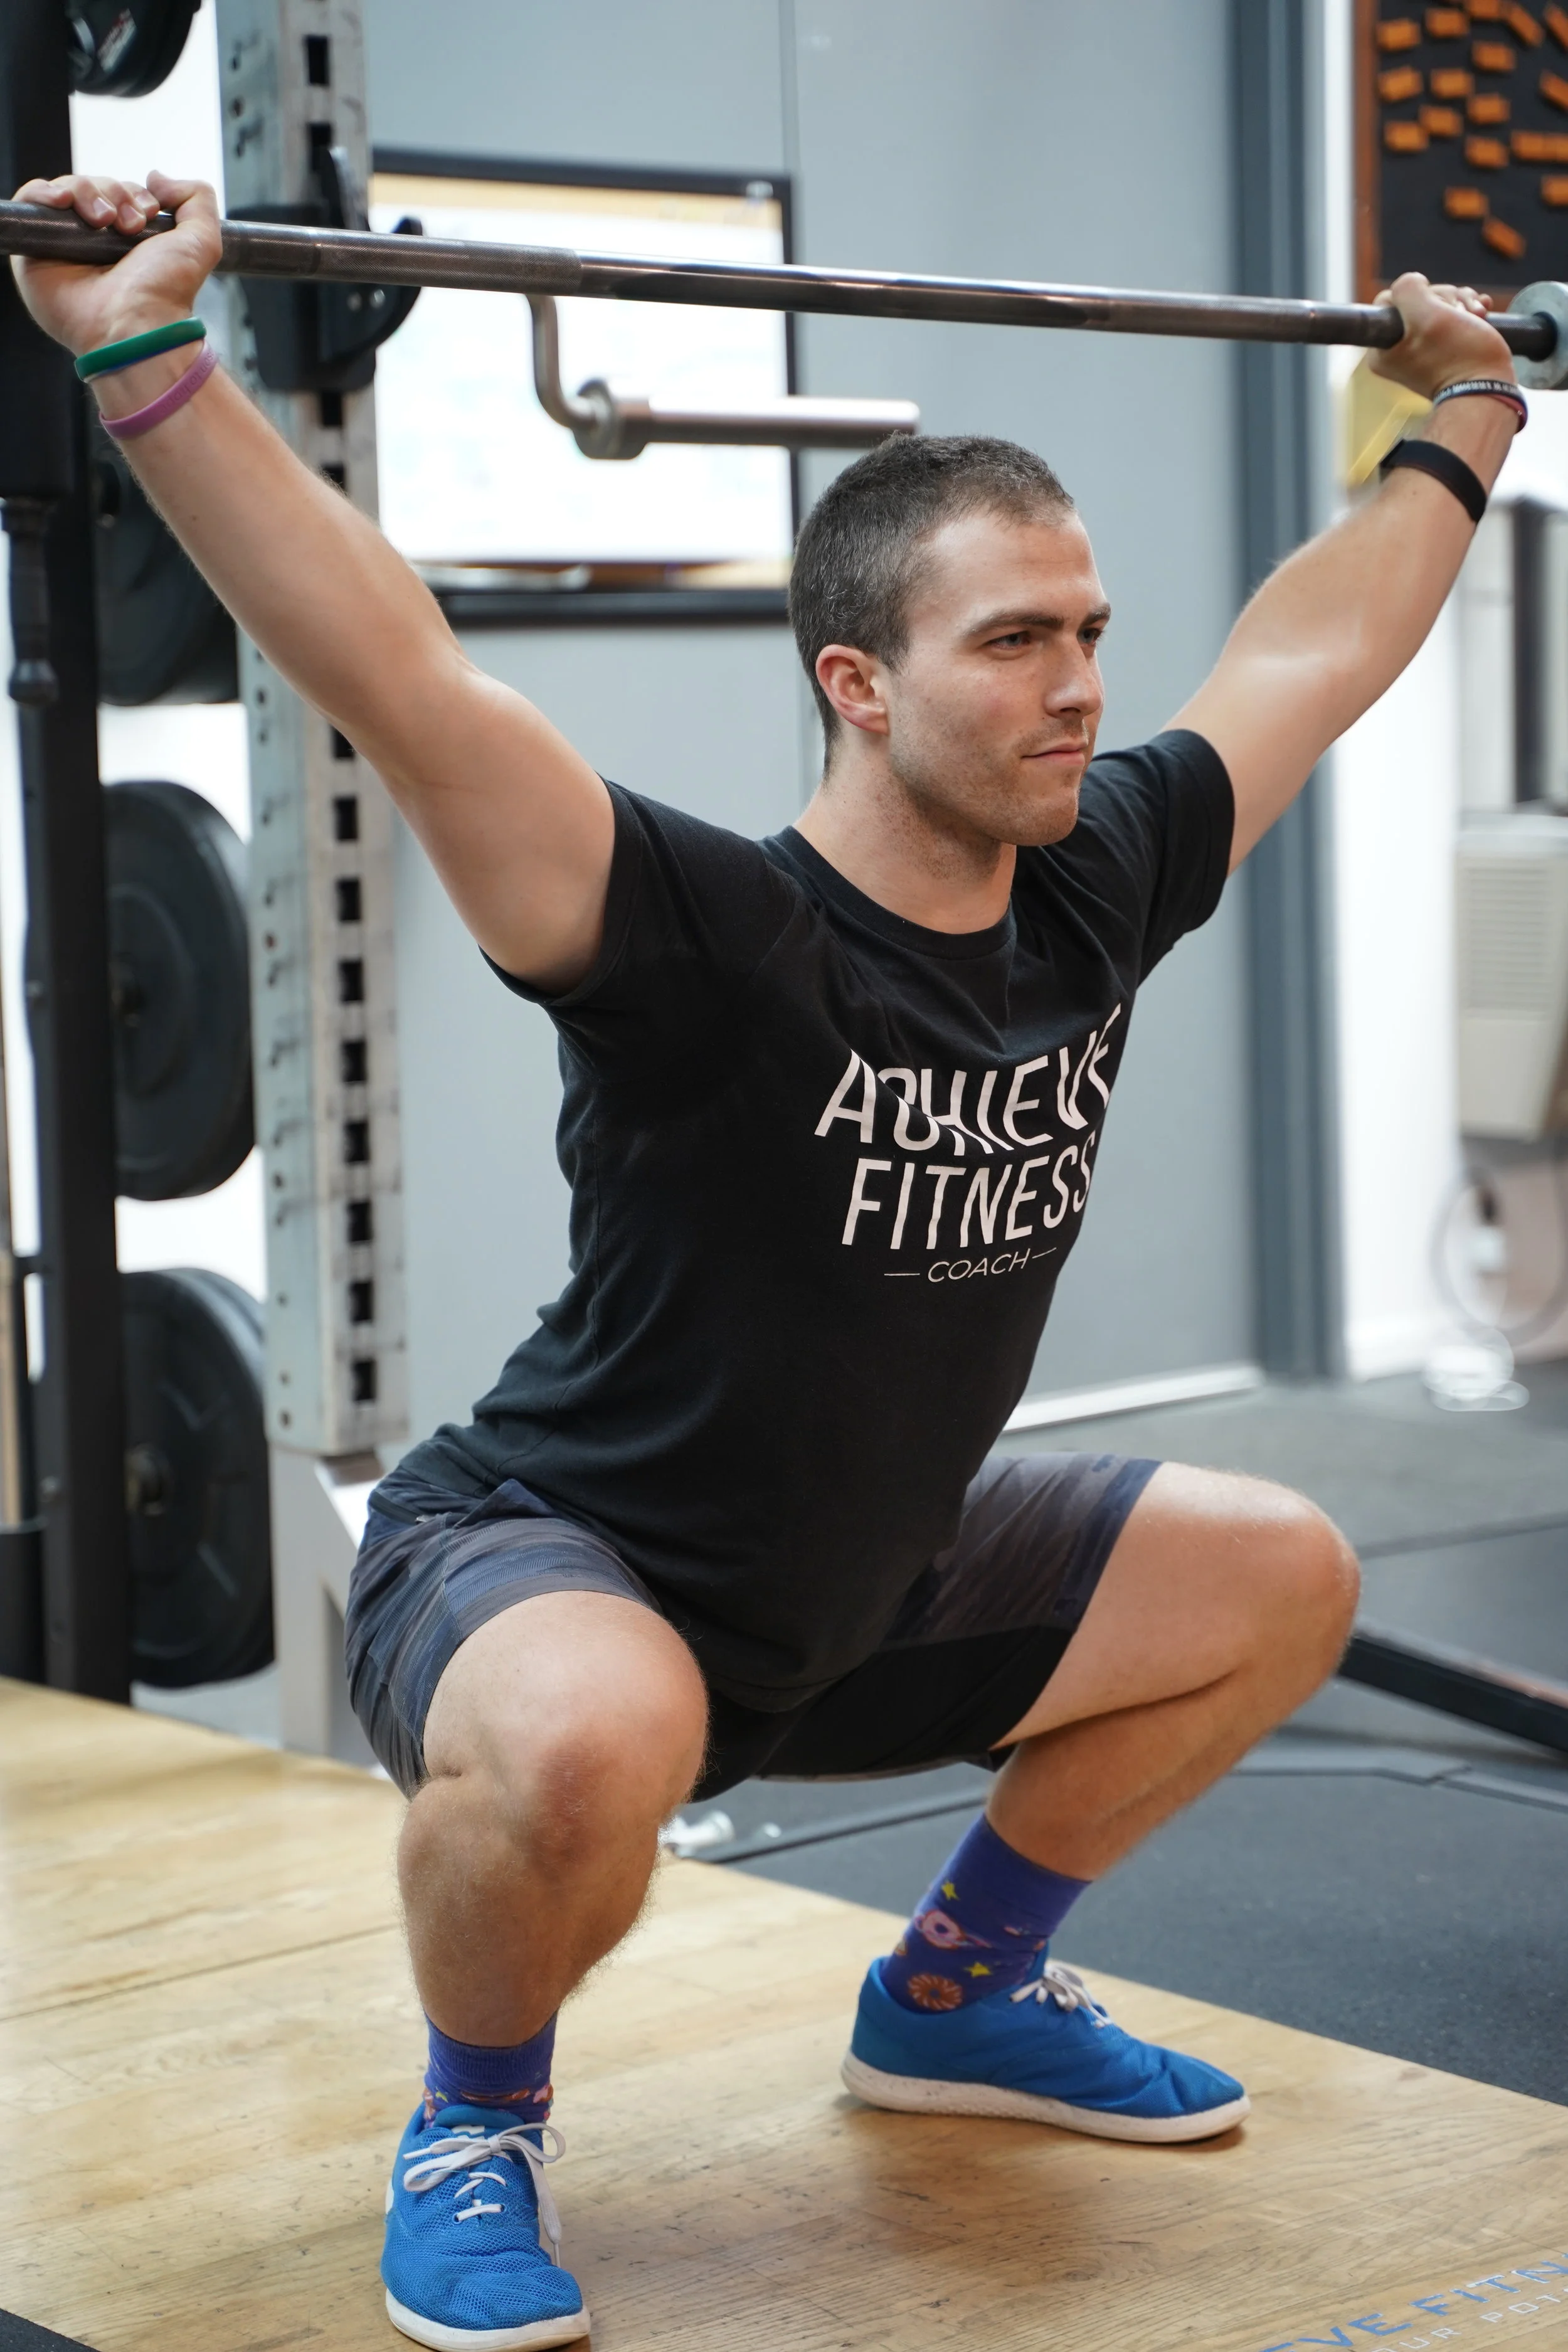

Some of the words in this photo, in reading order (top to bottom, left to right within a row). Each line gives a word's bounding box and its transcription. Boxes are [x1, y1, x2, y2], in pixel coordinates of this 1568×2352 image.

[814, 1003, 1121, 1156] ACHIEVE
[841, 1131, 1095, 1250] FITNESS
[927, 1248, 1031, 1283] COACH
[1259, 2312, 1413, 2352] VE
[1409, 2253, 1568, 2316] FITN
[1372, 2328, 1463, 2352] UR
[1479, 2288, 1568, 2324] POT
